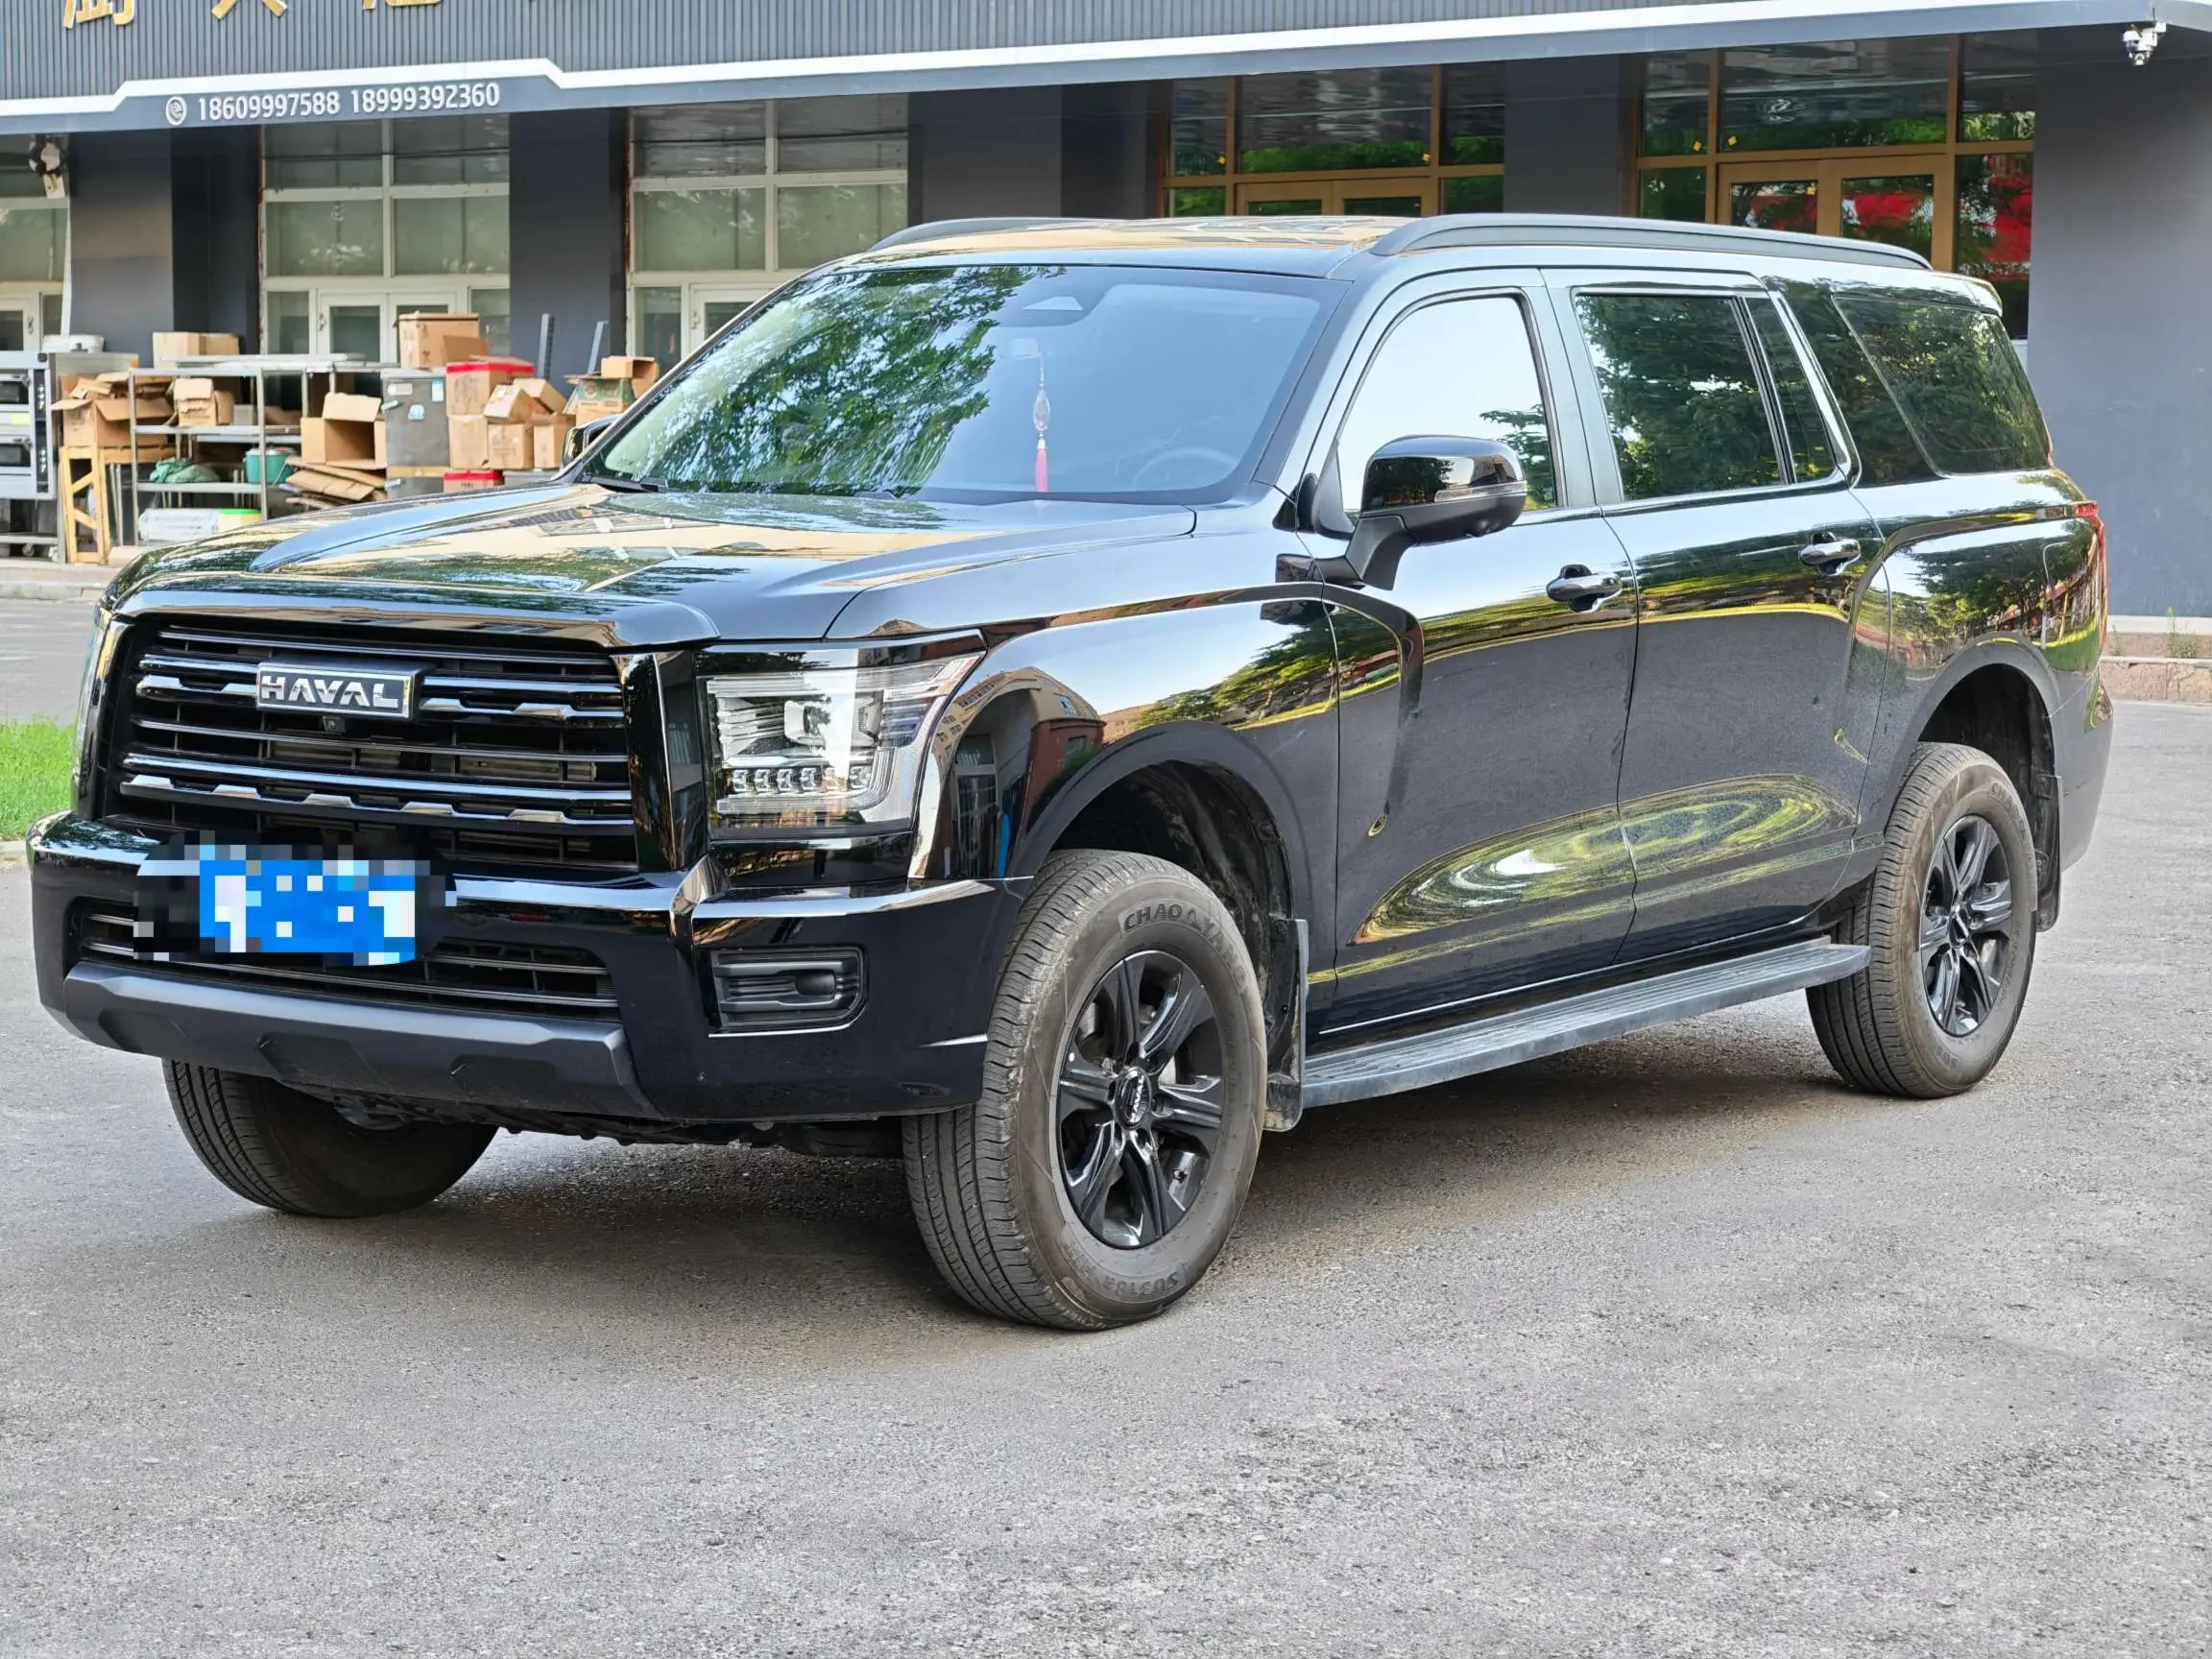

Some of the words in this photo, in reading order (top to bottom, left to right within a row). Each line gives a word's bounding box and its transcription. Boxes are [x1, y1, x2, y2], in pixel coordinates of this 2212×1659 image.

[198, 91, 341, 121] 18609997588
[349, 83, 500, 113] 18999392360
[261, 675, 398, 709] HAVAL
